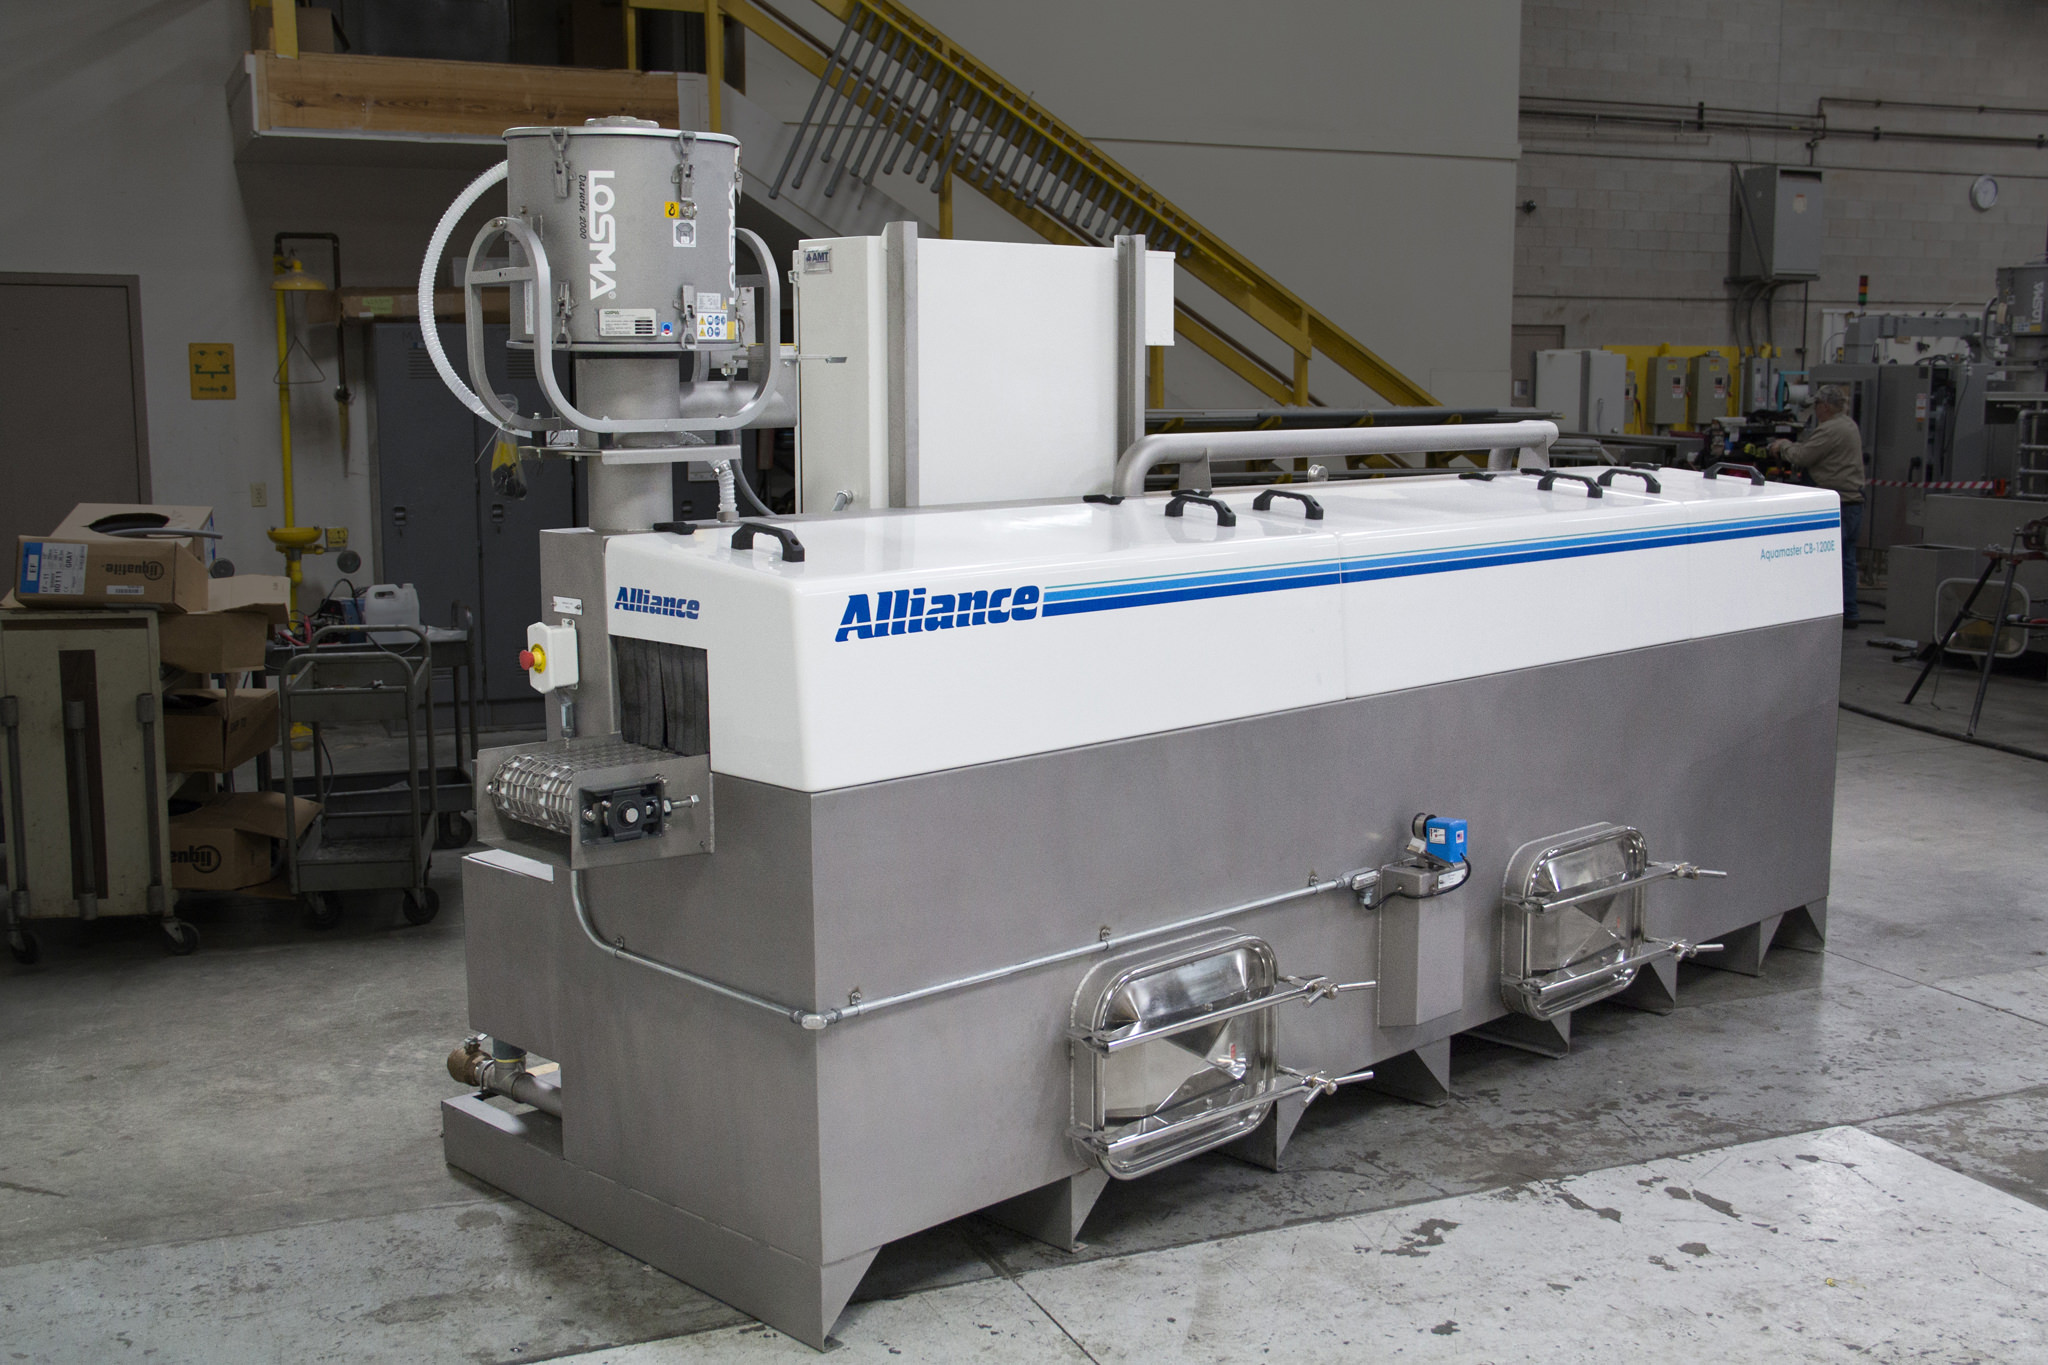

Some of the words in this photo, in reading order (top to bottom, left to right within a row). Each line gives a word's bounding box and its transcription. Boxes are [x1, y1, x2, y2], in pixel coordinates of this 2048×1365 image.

[578, 174, 587, 213] Darwin
[579, 216, 587, 240] 2000
[588, 170, 616, 300] LOSMA
[811, 251, 829, 262] AMT
[2032, 281, 2045, 323] LOSMA
[65, 551, 73, 569] GRAY
[1760, 545, 1802, 561] Aquamaster
[1803, 540, 1835, 554] CB-1200E
[29, 563, 37, 574] EF
[614, 585, 700, 620] Alliance
[834, 584, 1040, 643] Alliance
